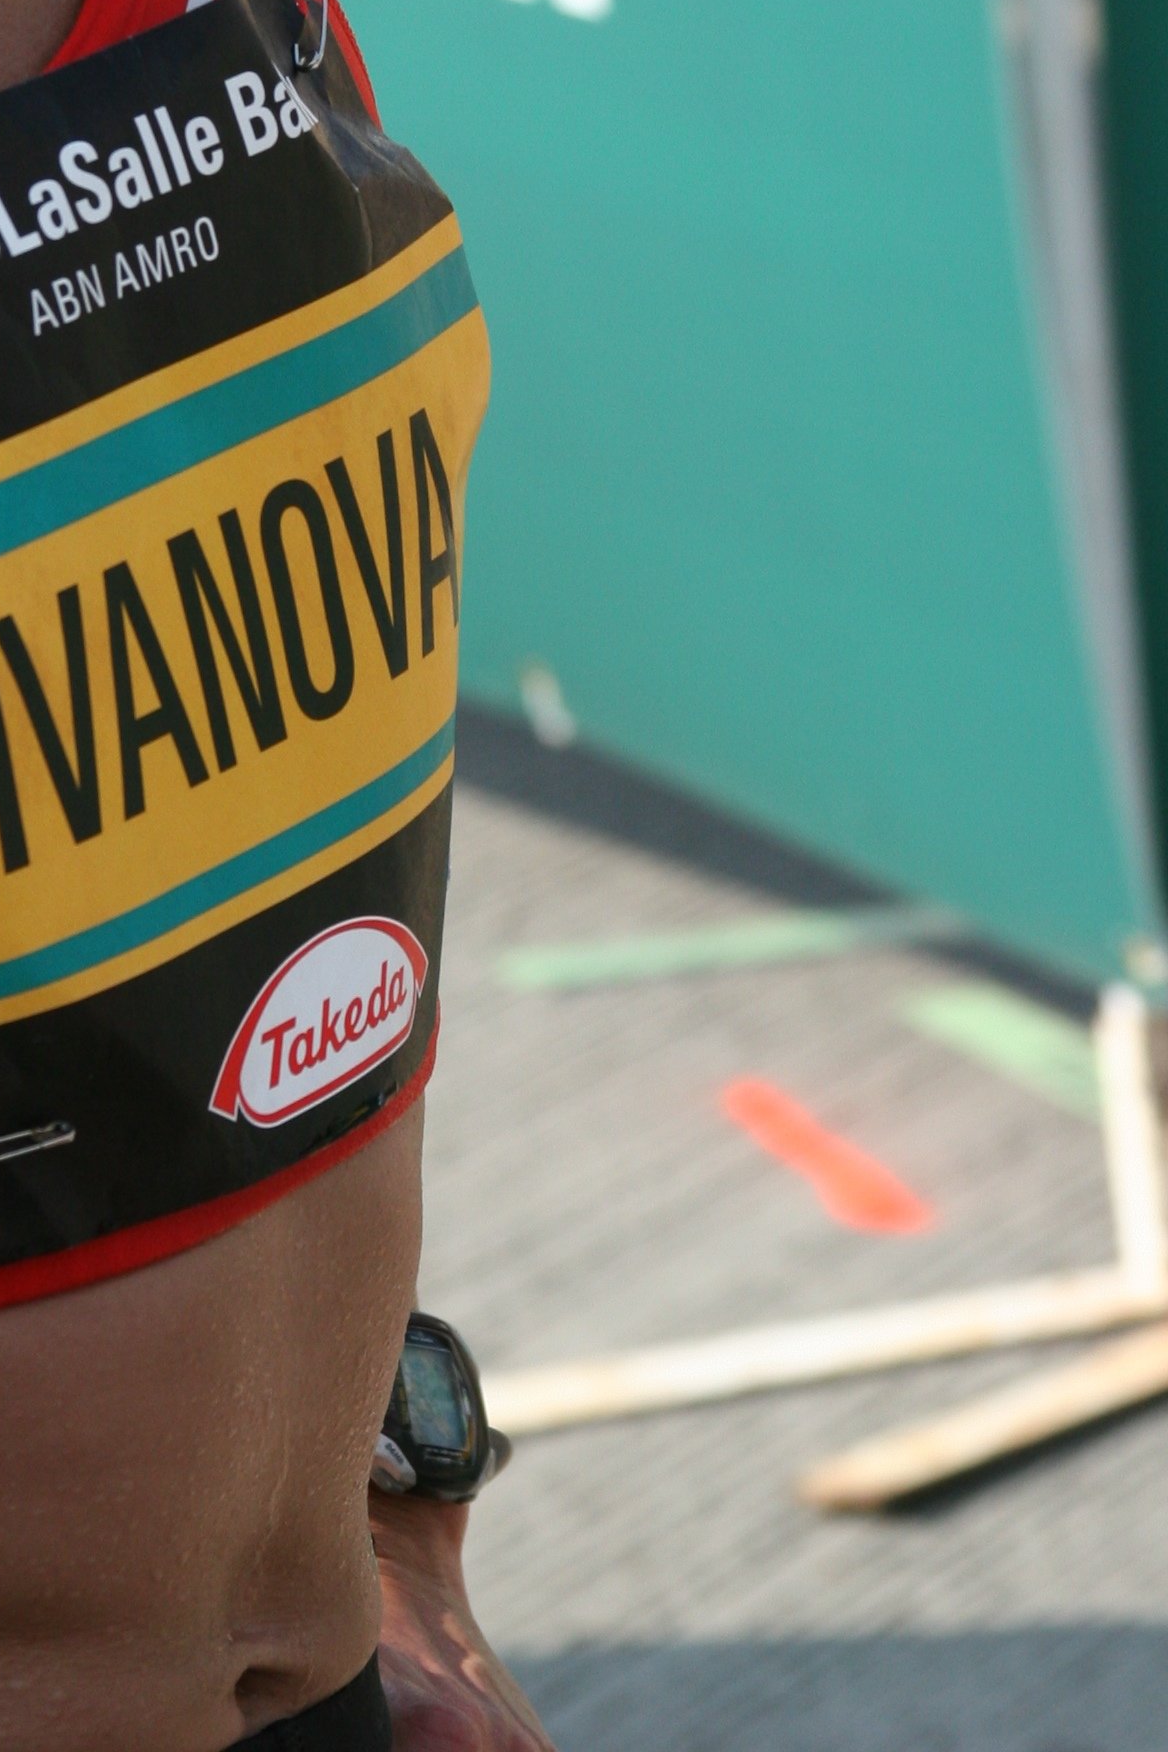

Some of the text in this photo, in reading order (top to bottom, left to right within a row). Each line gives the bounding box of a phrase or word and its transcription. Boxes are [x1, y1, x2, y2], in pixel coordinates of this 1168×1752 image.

[225, 70, 318, 156] Ba
[30, 217, 221, 336] ABN AMRO
[261, 960, 407, 1090] Takeda
